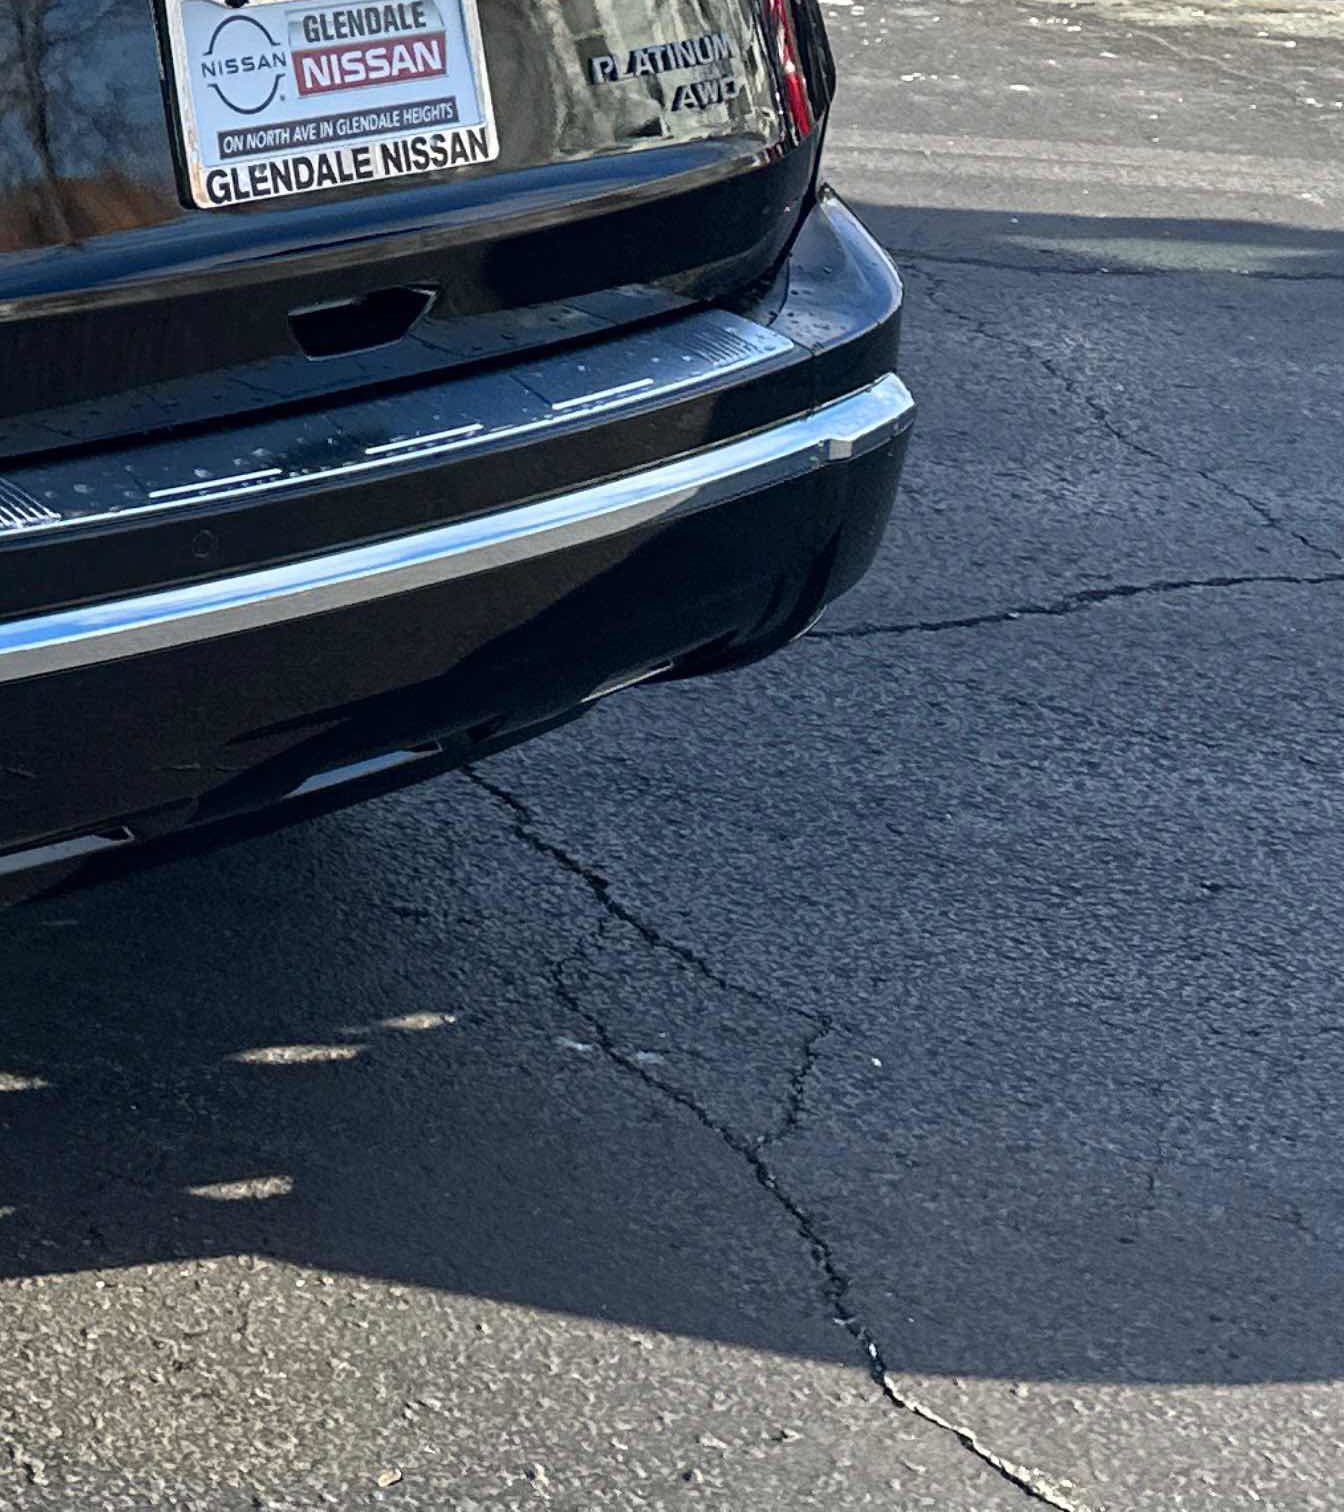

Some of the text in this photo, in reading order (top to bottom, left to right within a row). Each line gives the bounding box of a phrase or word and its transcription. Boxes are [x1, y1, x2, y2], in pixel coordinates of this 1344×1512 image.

[302, 1, 427, 44] GLENDALE
[200, 51, 287, 80] NISSAN
[300, 40, 443, 89] NISSAN
[589, 32, 737, 85] PLATINUM
[670, 75, 740, 112] AWD
[222, 101, 454, 154] ON NORTH AVE IN GLENDALE HEIGHTS
[205, 128, 490, 206] GLENDALE NISSAN
